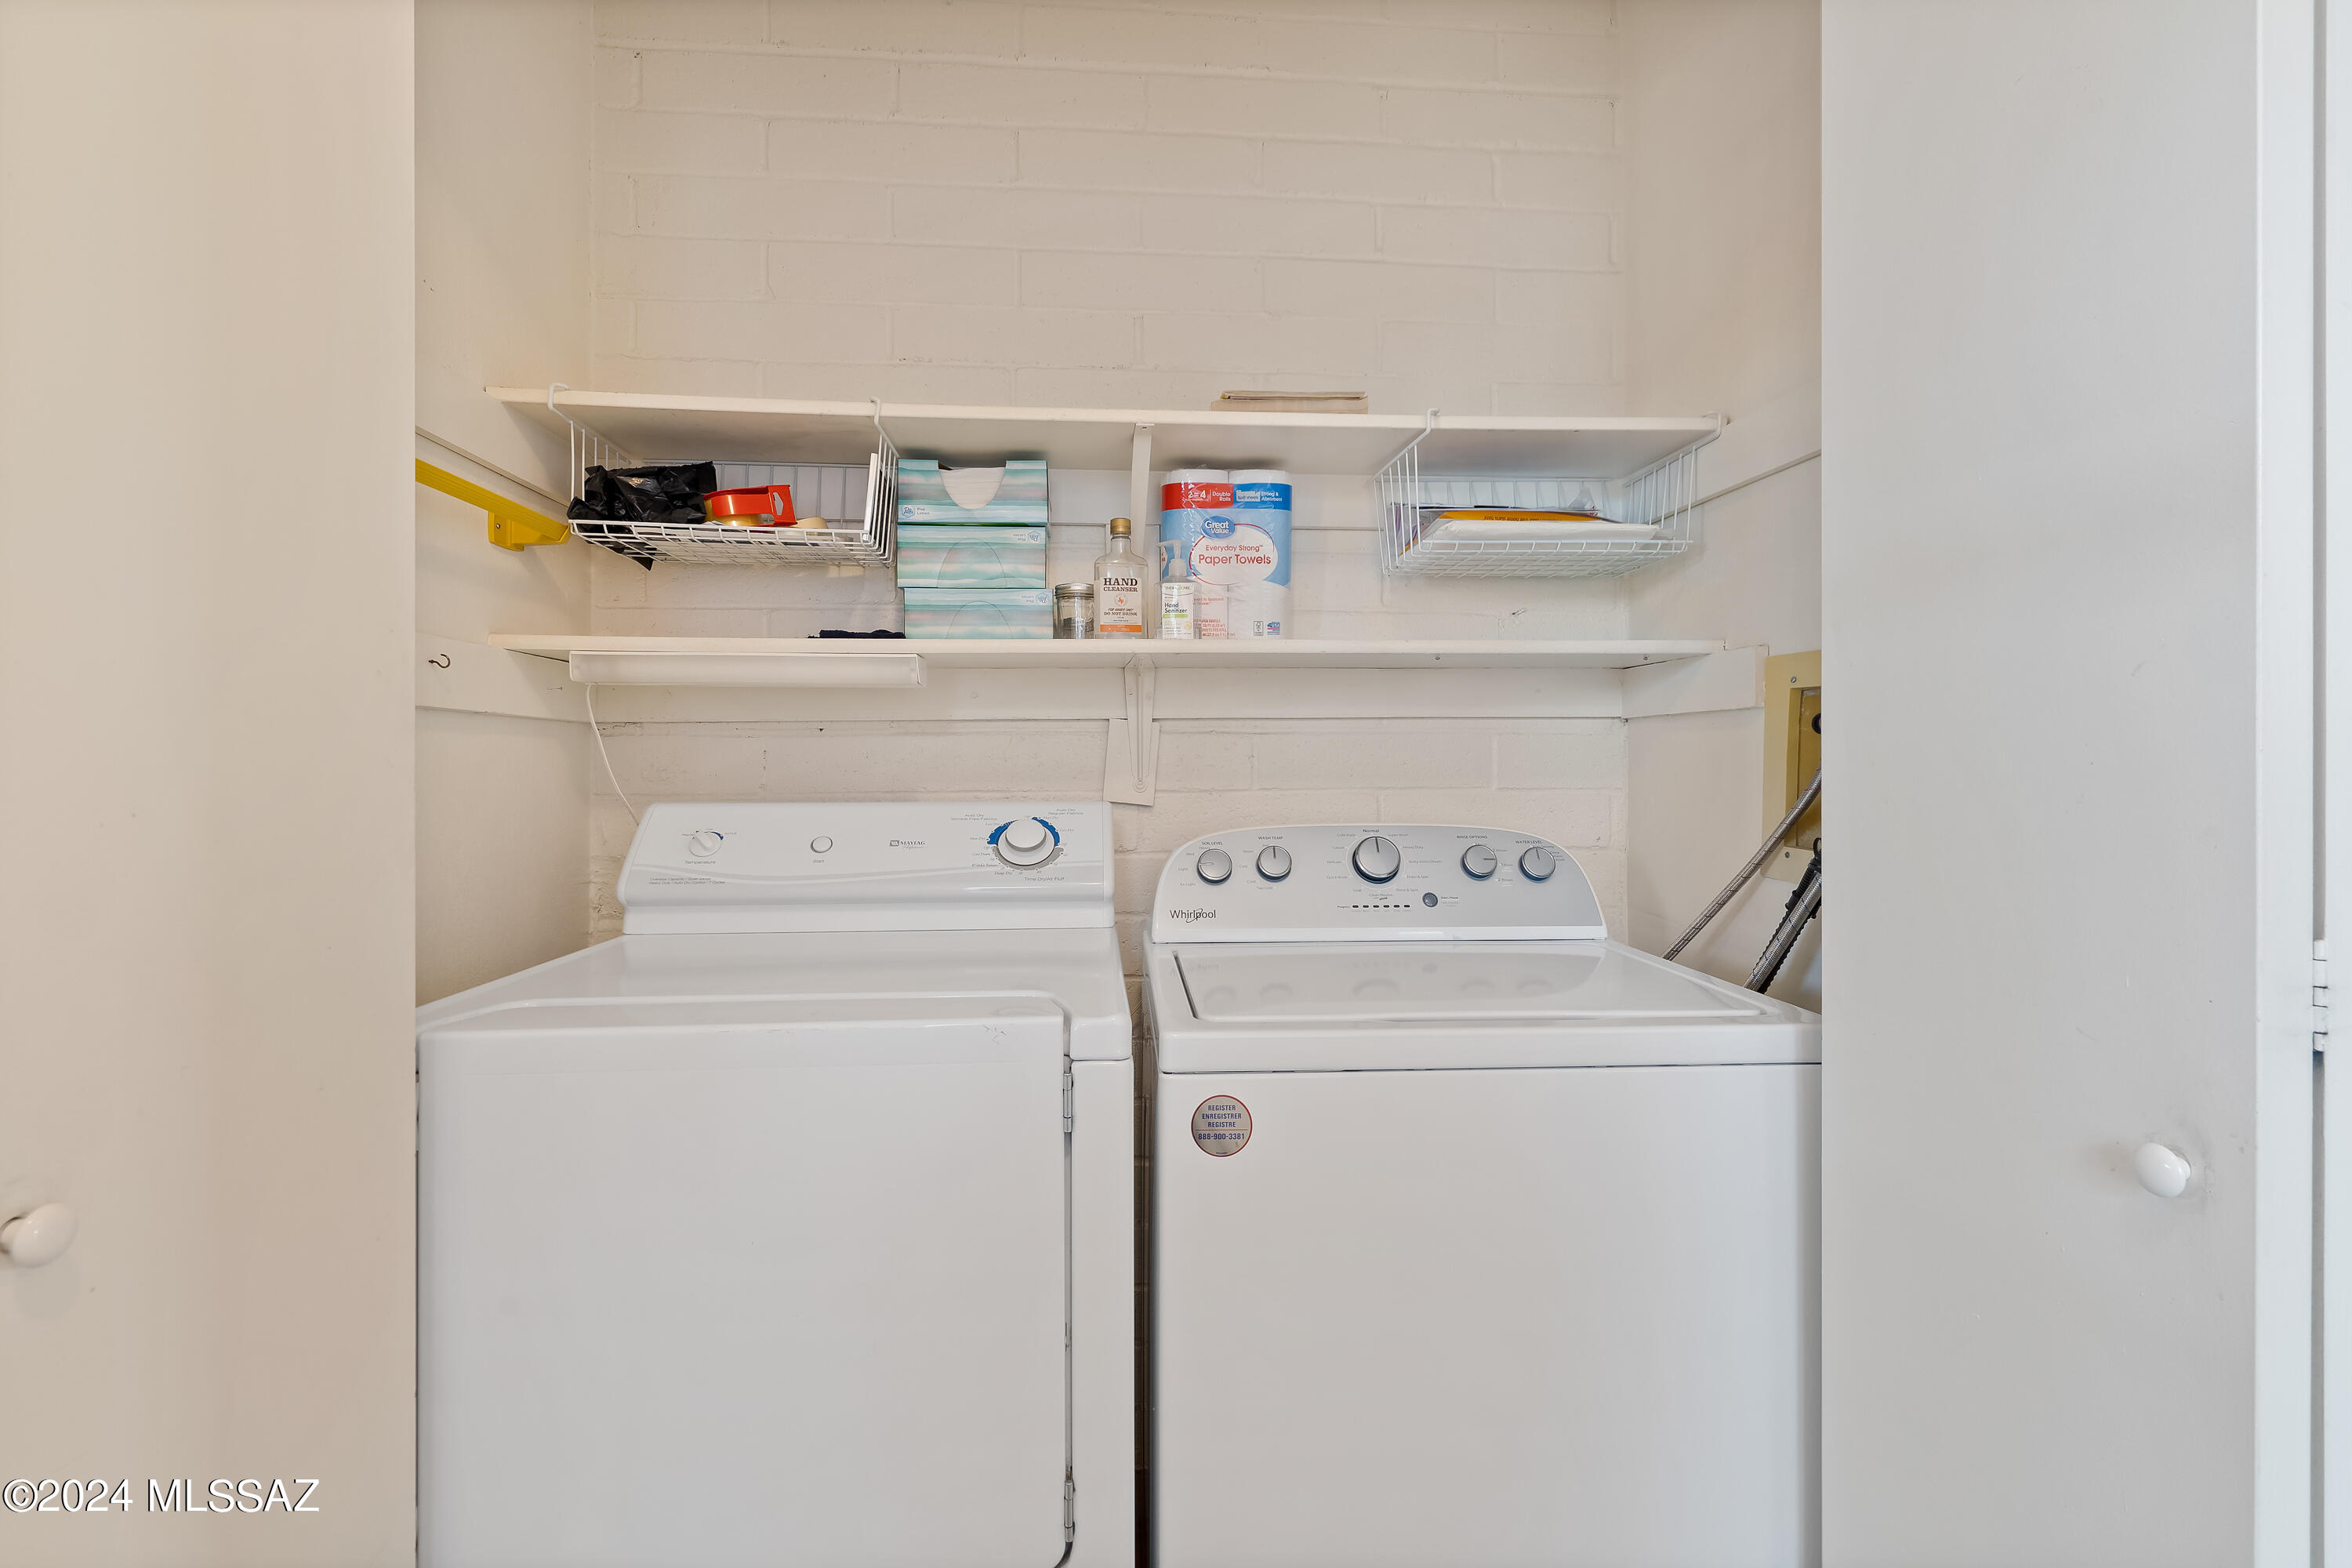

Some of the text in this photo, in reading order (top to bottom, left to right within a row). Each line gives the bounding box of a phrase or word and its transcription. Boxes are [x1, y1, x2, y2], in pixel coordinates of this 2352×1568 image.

[1198, 554, 1272, 566] Paper Towels
[1104, 578, 1138, 586] HAND
[1170, 909, 1216, 921] Whirlpool
